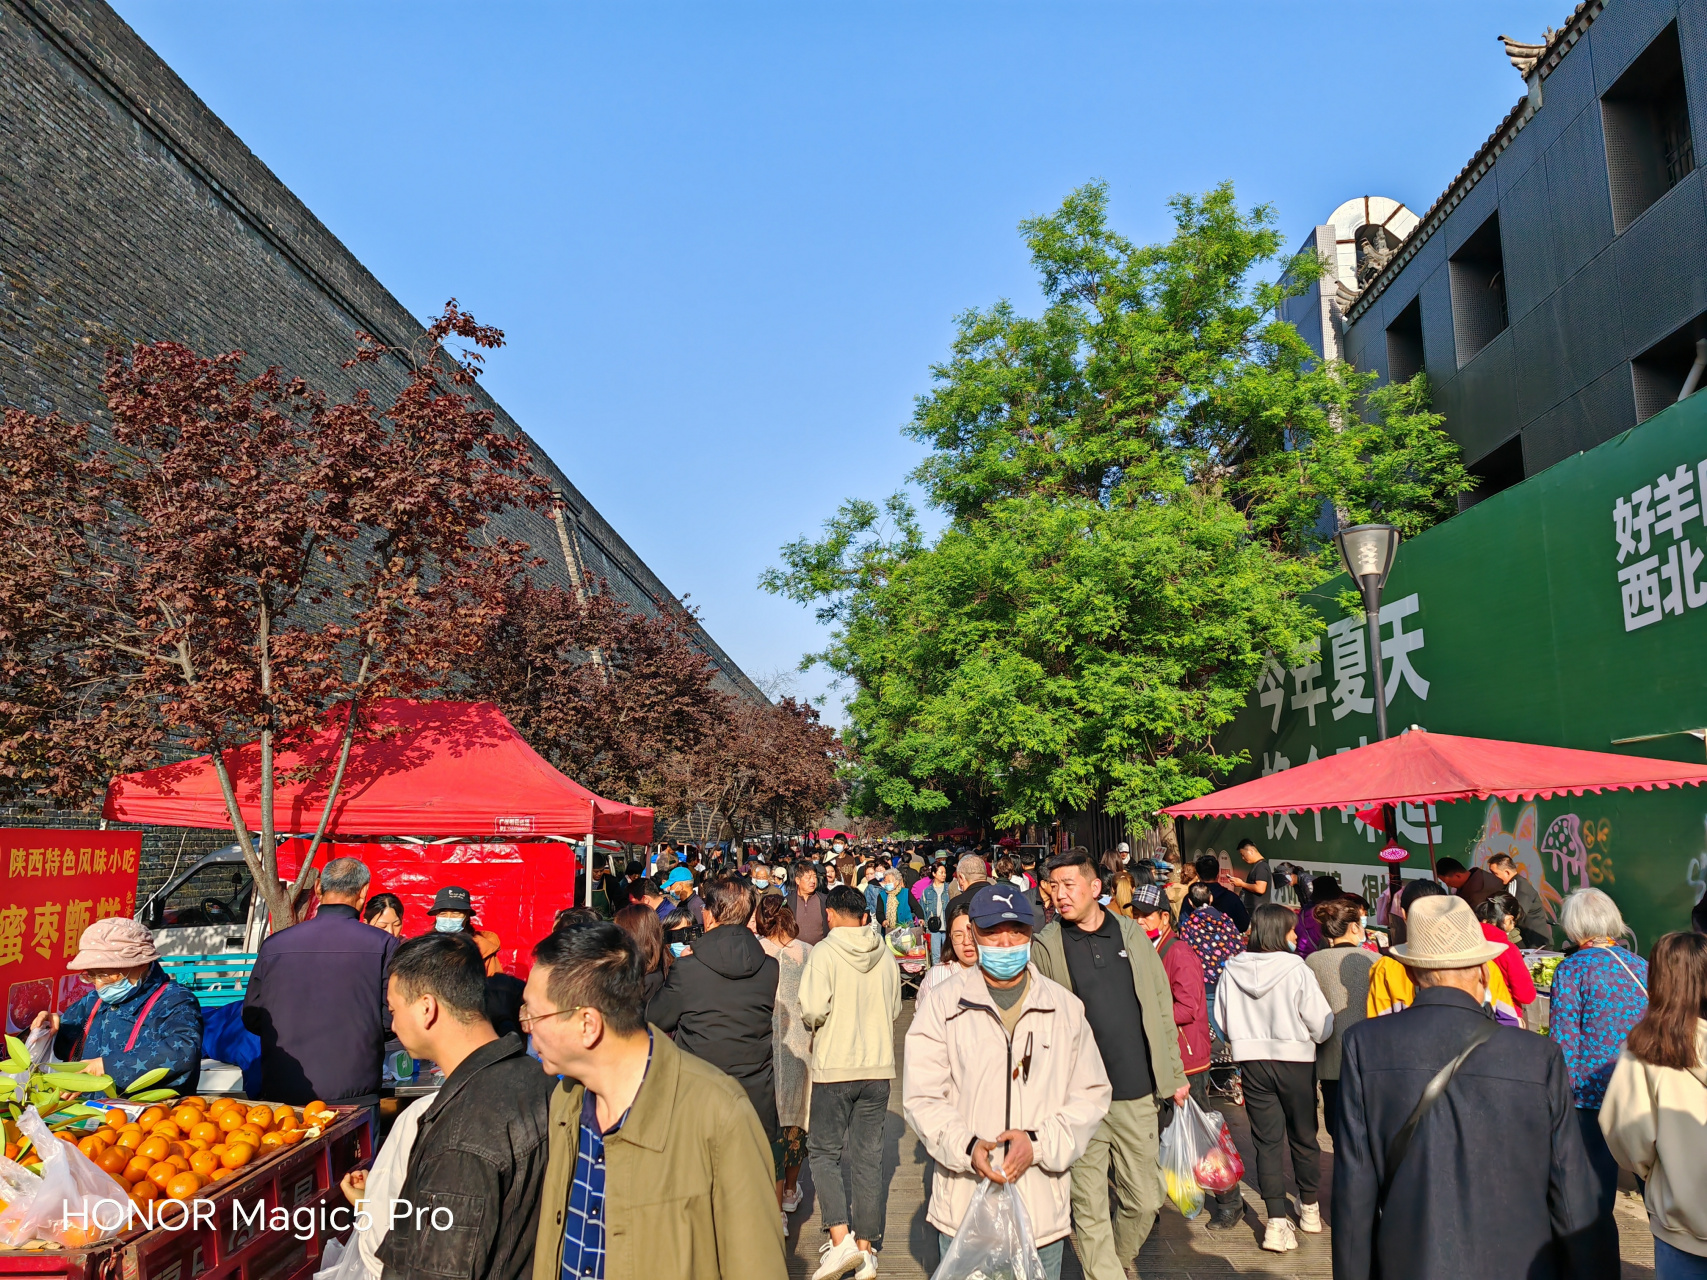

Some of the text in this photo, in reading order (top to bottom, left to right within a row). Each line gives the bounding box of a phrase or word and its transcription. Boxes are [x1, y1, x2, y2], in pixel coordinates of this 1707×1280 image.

[1613, 459, 1707, 564] 好羊
[1618, 539, 1707, 632] 西北
[1257, 593, 1430, 734] 今年夏天
[9, 848, 136, 878] 陕西特色风味小吃
